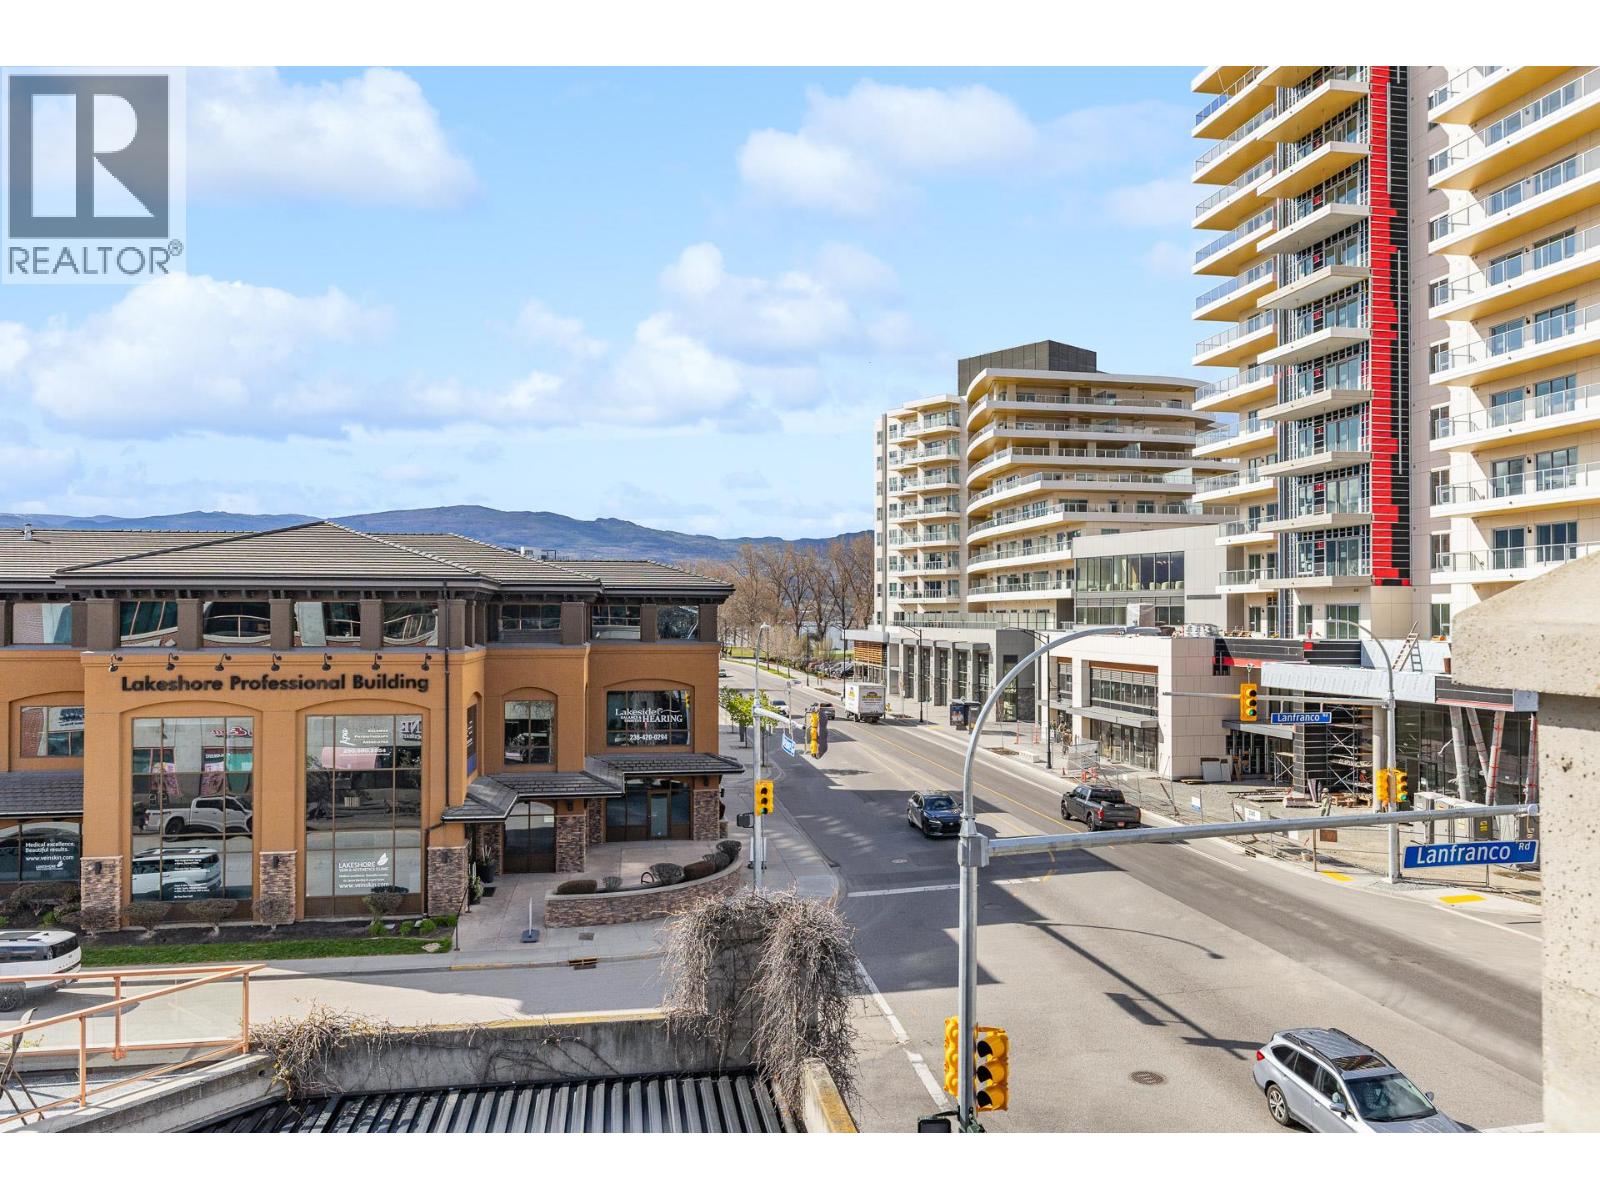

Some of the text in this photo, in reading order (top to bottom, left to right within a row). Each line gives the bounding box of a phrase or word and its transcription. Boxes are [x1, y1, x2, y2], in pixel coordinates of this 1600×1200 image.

[121, 673, 429, 692] Lakeshore Professional Building
[615, 708, 657, 716] Lakeside
[642, 714, 683, 723] HEARING
[1277, 713, 1320, 722] Lanfranco
[1416, 842, 1530, 864] Lanfranco Rd
